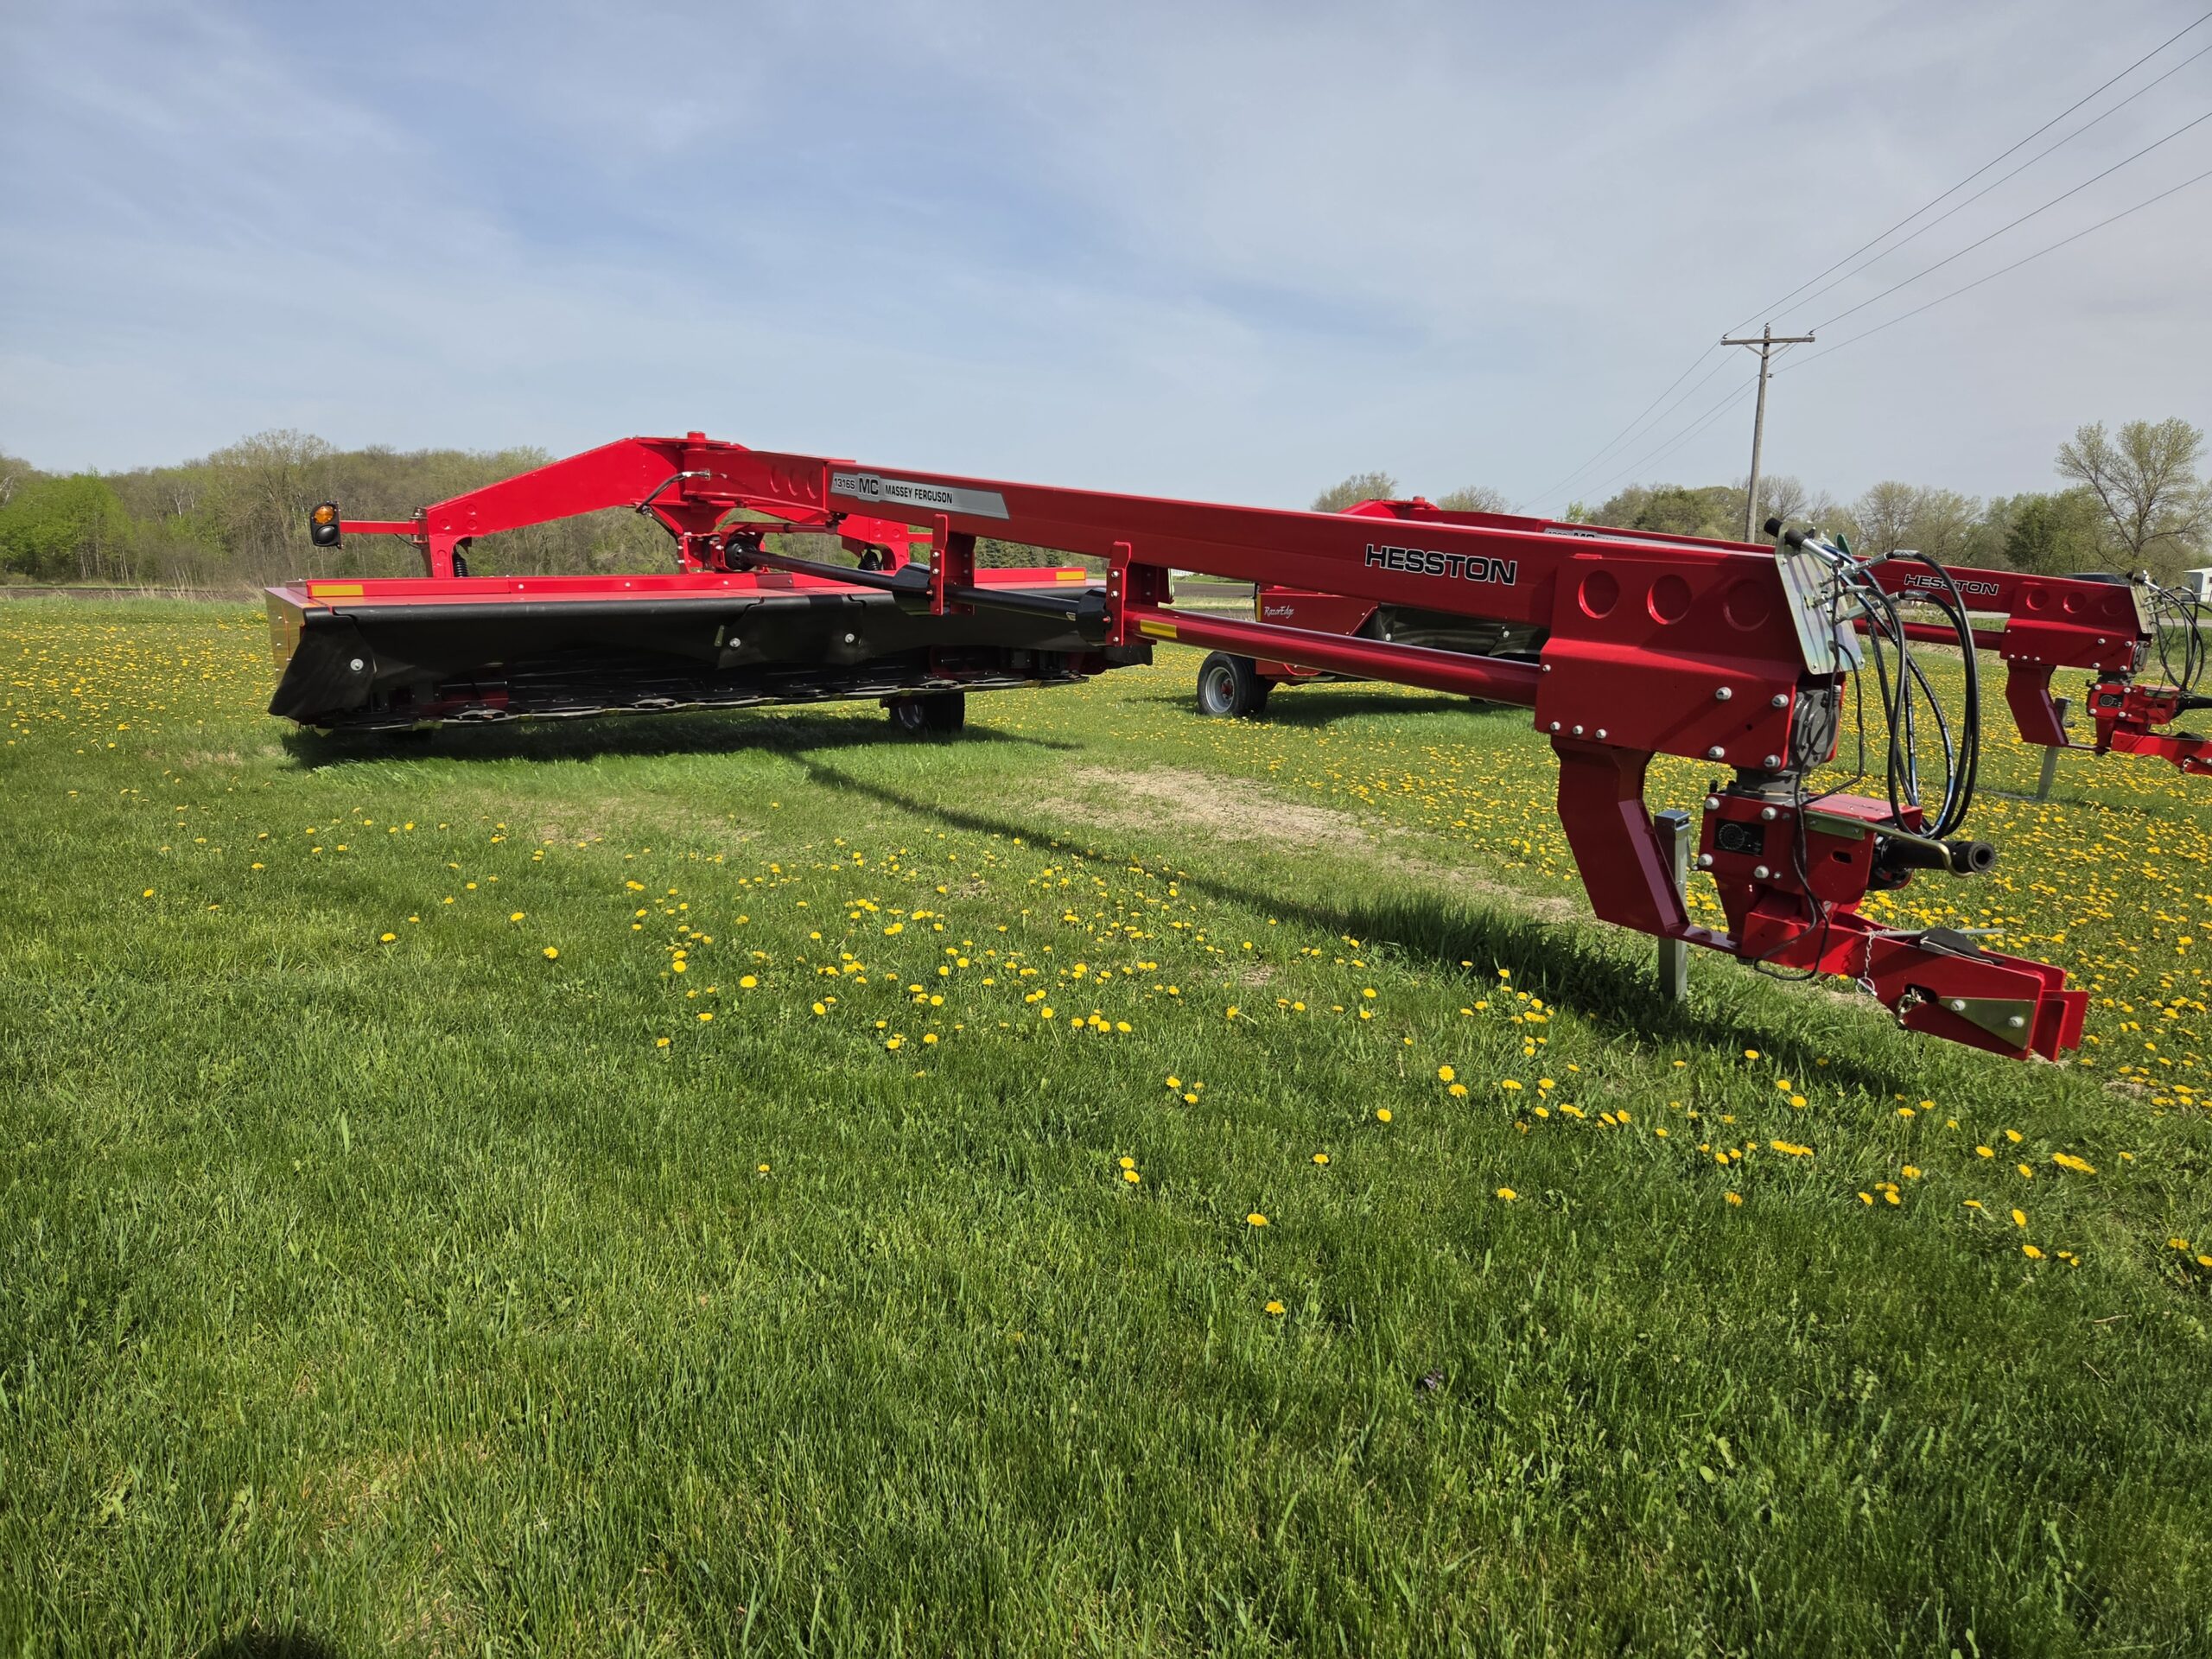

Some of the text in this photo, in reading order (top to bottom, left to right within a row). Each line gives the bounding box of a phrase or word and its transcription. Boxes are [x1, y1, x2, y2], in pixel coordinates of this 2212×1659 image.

[859, 477, 879, 495] MC
[885, 485, 952, 504] MASSEY FERGUSON
[1365, 544, 1517, 585] HESSTON
